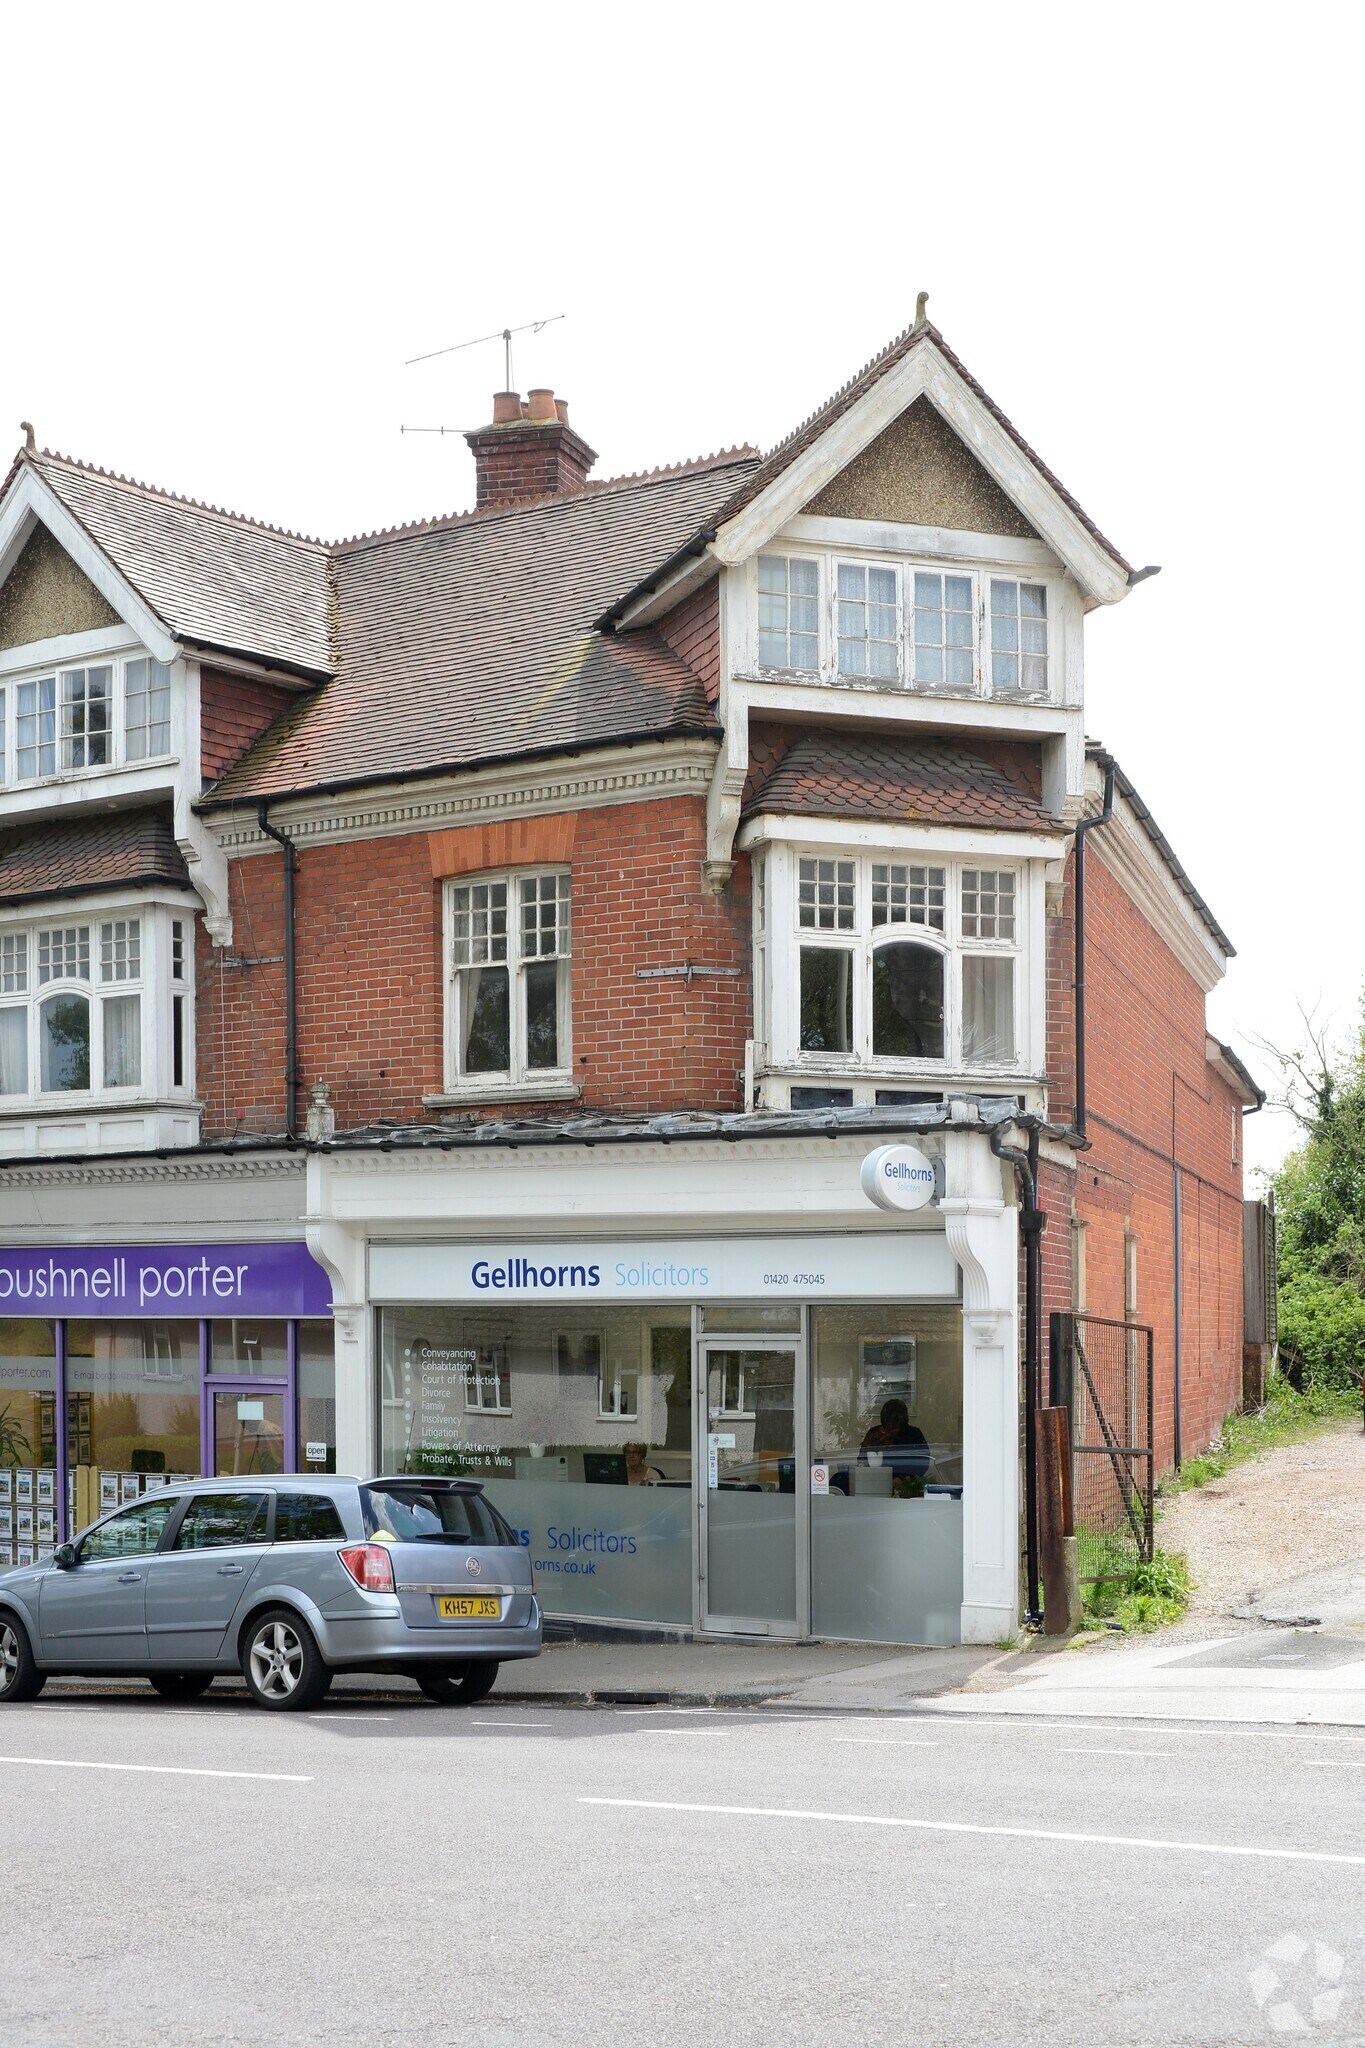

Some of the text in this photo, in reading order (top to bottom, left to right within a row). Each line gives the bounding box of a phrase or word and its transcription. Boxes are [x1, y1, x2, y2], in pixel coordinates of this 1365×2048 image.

[884, 1162, 932, 1182] Gellhorns
[897, 1181, 921, 1193] Solicitors
[471, 1258, 825, 1289] Gellhorns Solicitors 01420 475045
[140, 1256, 248, 1307] porter
[421, 1347, 477, 1360] Conveyancing
[421, 1361, 473, 1372] Cohabitation
[421, 1374, 501, 1386] Court of Protection
[421, 1387, 451, 1398] Divorce
[421, 1401, 446, 1412] Family
[421, 1414, 462, 1426] Insolvency
[421, 1427, 459, 1439] Litigation
[307, 1447, 326, 1456] open
[421, 1440, 501, 1455] Powers of Attorney
[421, 1453, 512, 1467] Probate, Trusts & Wills
[547, 1526, 637, 1554] Solicitors
[532, 1560, 596, 1575] orns.co.uk
[444, 1600, 497, 1615] KH57 JXS
